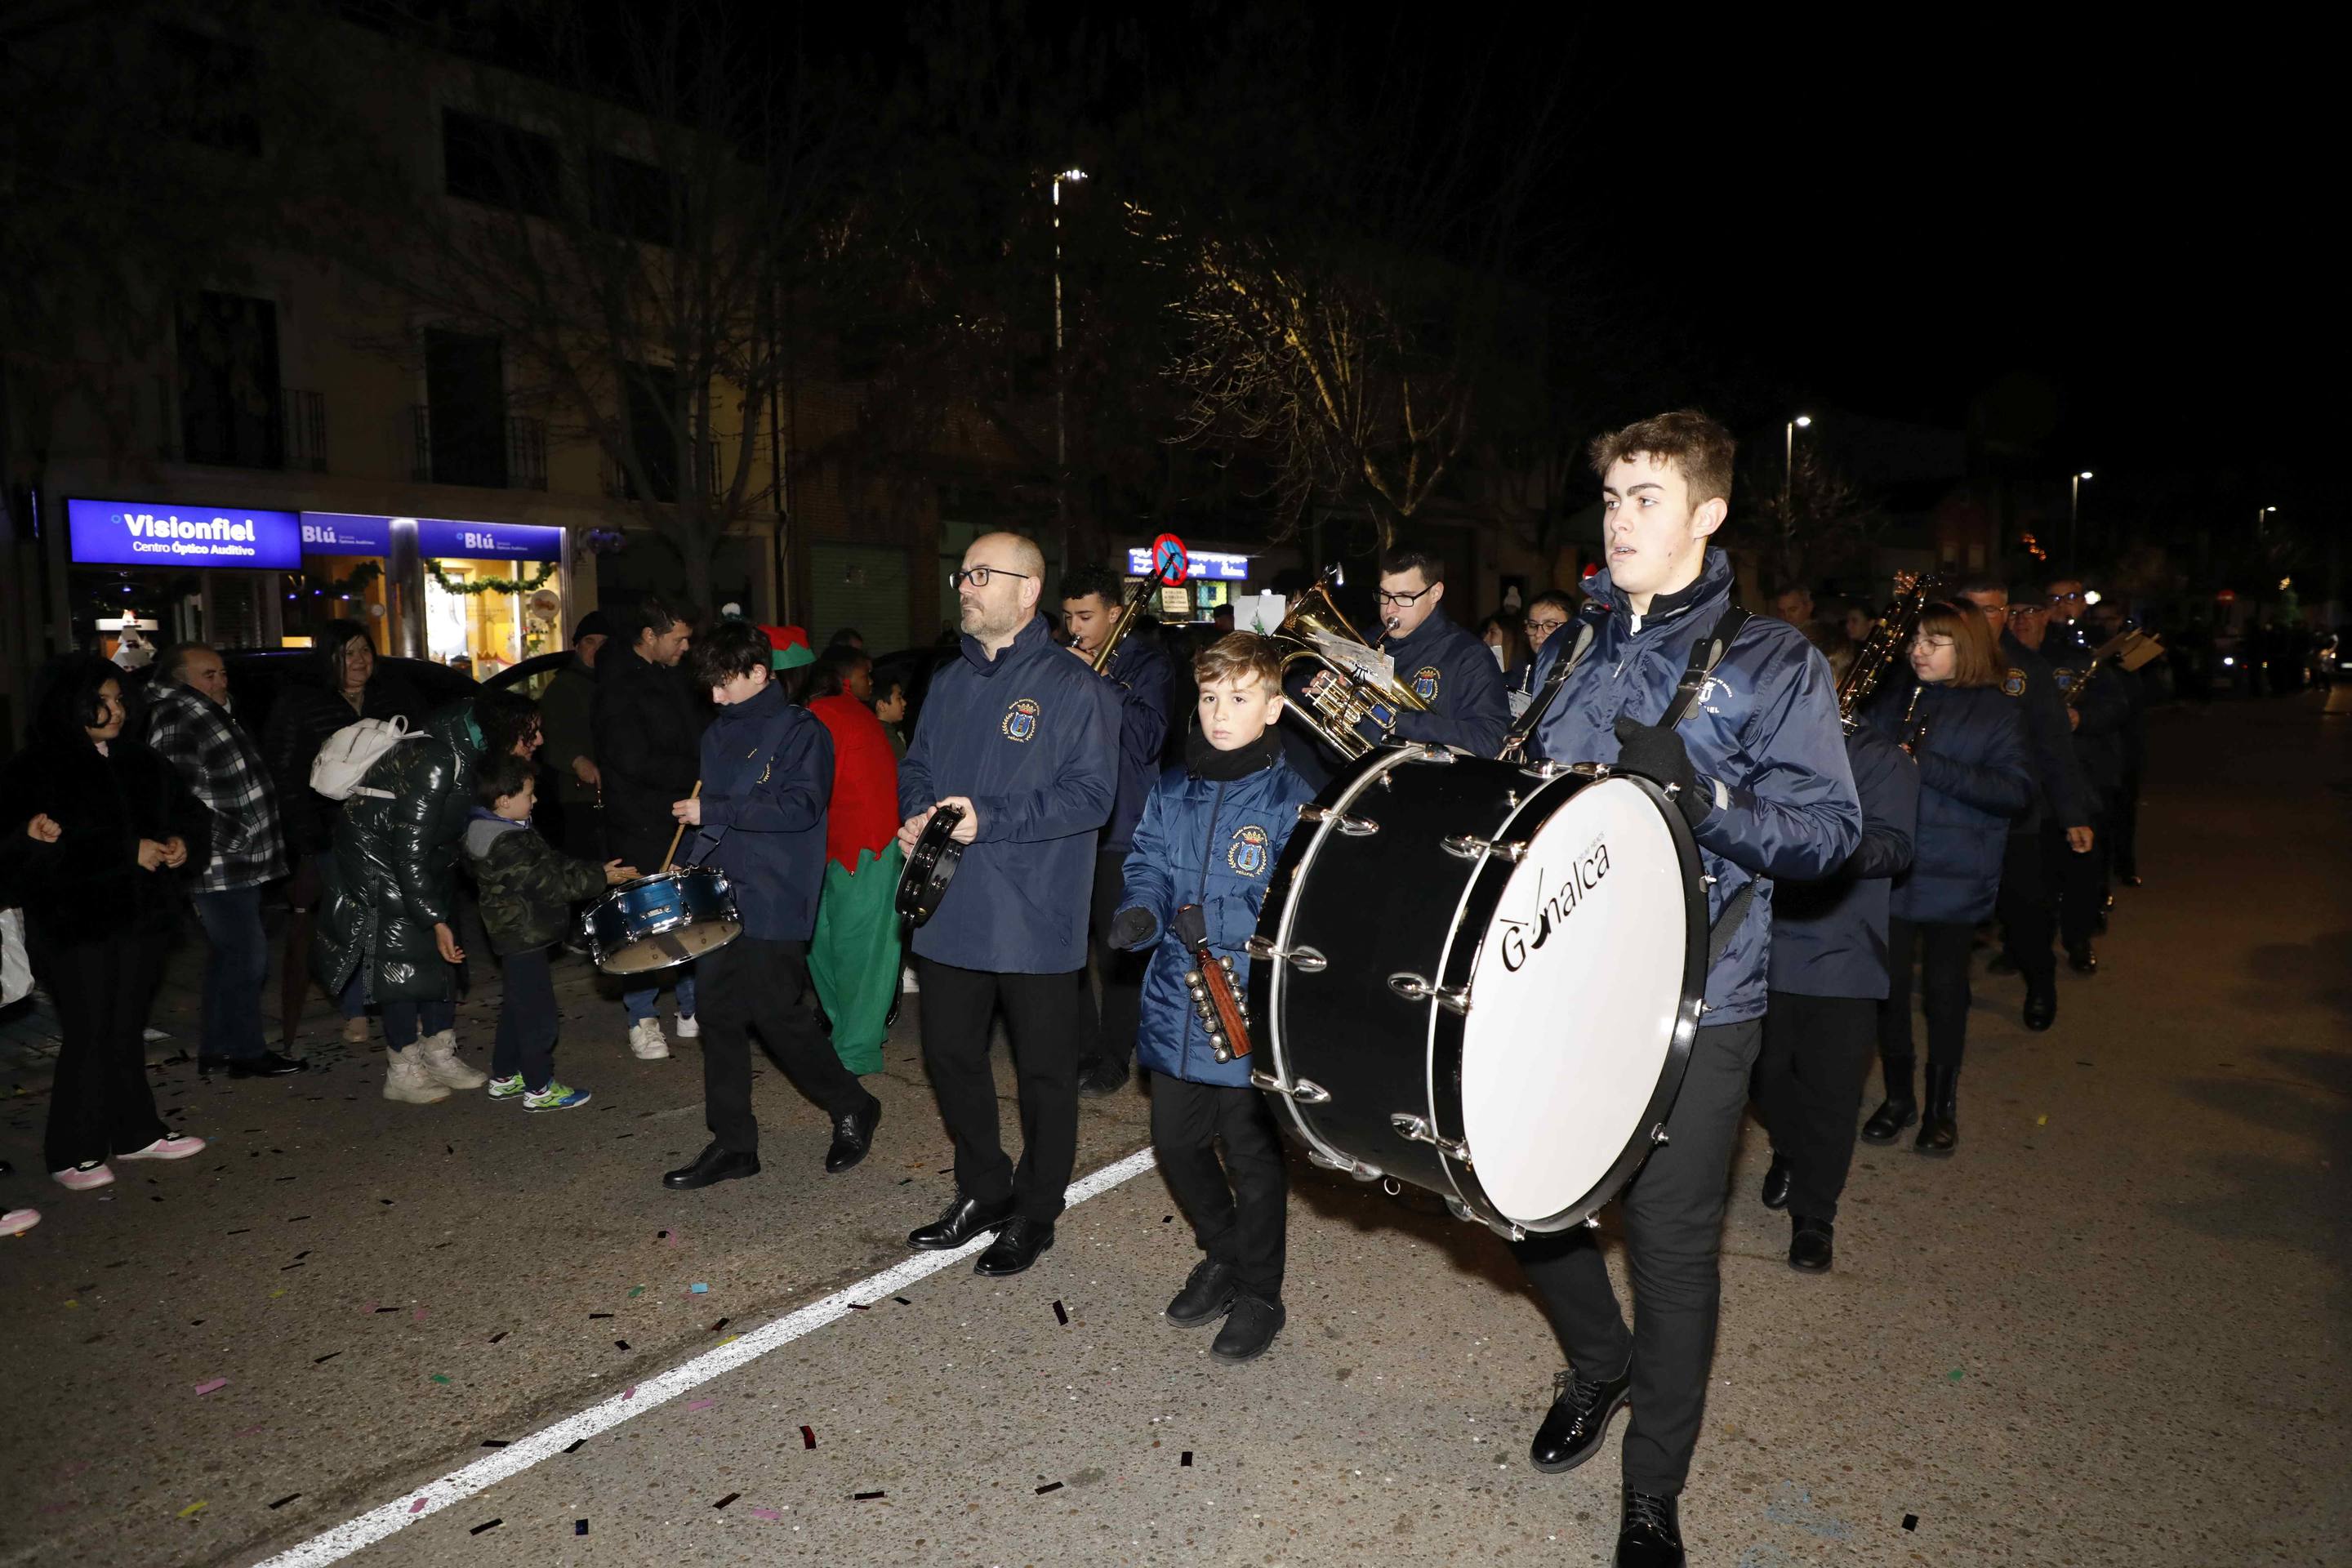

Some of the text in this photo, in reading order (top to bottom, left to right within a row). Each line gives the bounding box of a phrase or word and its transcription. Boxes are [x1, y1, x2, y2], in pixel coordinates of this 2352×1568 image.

[123, 514, 256, 541] Visionfiel
[301, 525, 336, 543] Blú
[132, 541, 256, 556] Centro Óptico Auditivo
[465, 532, 495, 550] Blú
